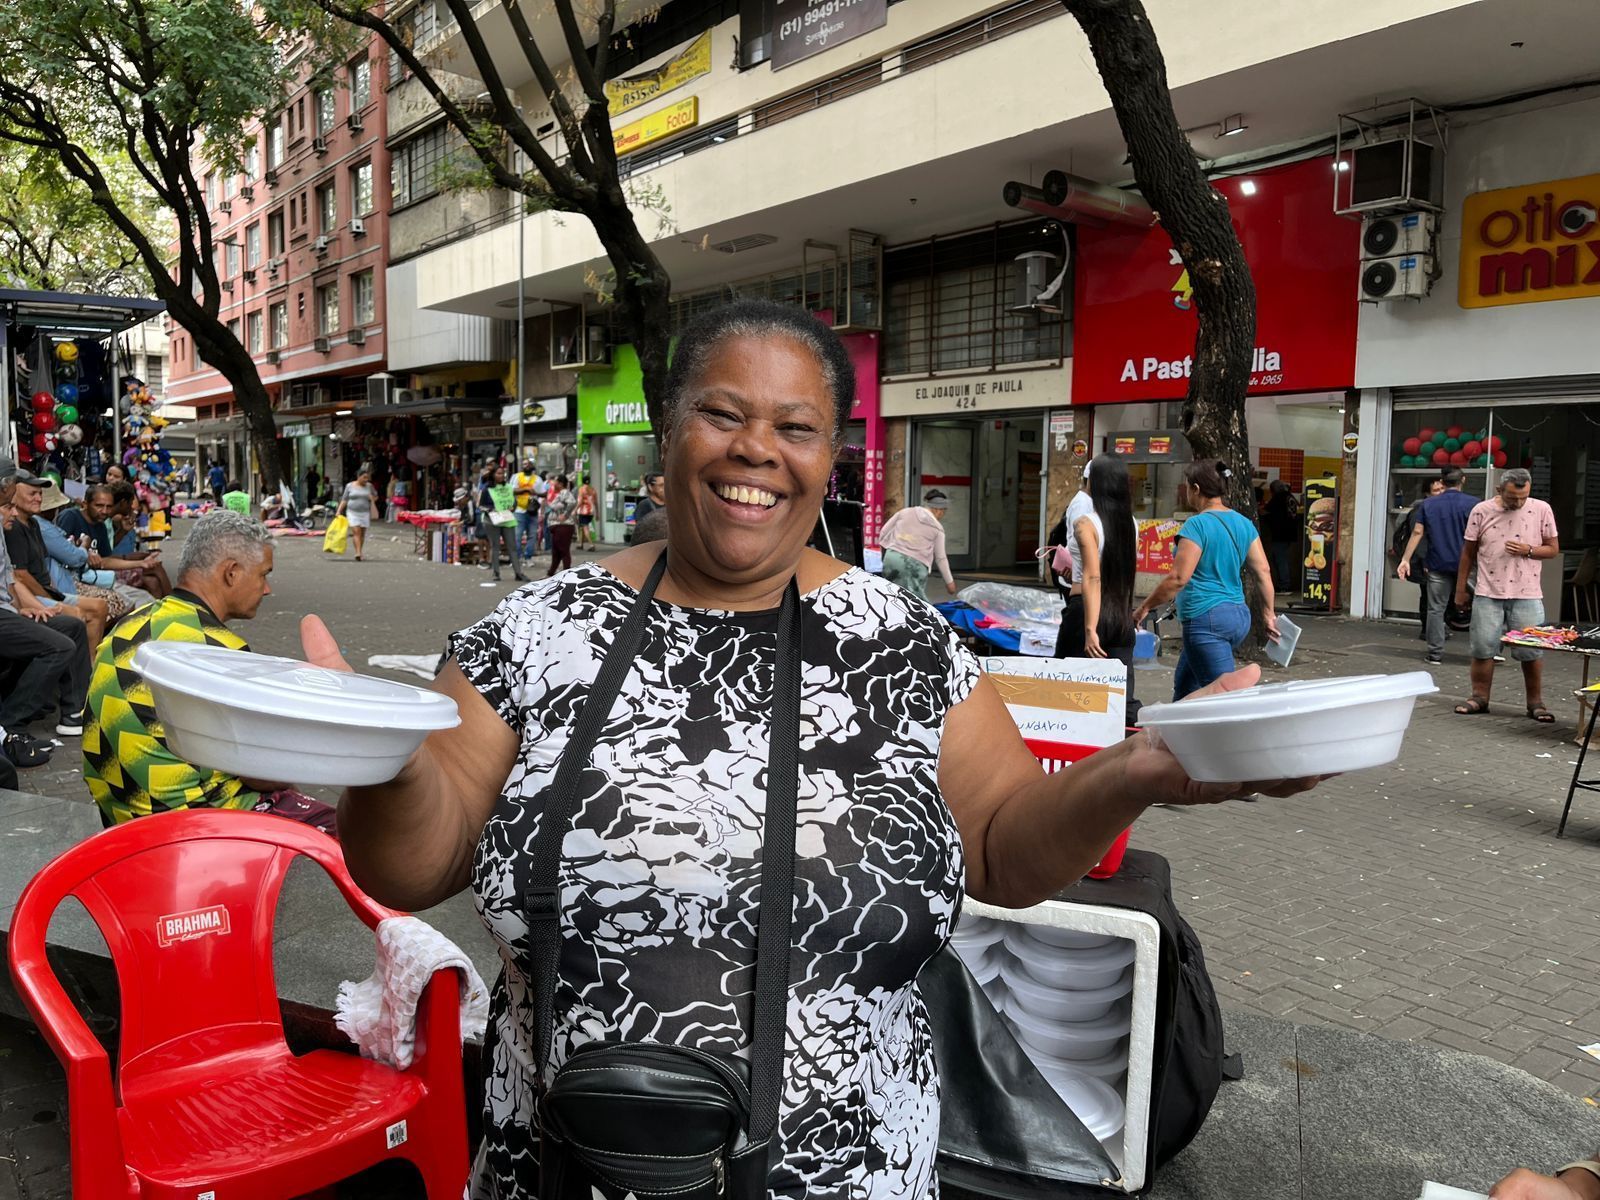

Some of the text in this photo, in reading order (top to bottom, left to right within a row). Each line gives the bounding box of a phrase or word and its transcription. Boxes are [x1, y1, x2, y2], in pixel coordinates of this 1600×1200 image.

[780, 17, 802, 40] (31)
[804, 0, 865, 26] 99491-1
[1480, 193, 1600, 248] otic
[1120, 359, 1138, 382] A
[1260, 374, 1283, 386] 1965
[931, 384, 970, 398] JOAQUIM
[975, 382, 987, 395] DE
[992, 379, 1023, 394] PAULA
[606, 400, 642, 424] ÓPTICA
[956, 397, 976, 409] 424
[165, 910, 222, 937] BRAHMA
